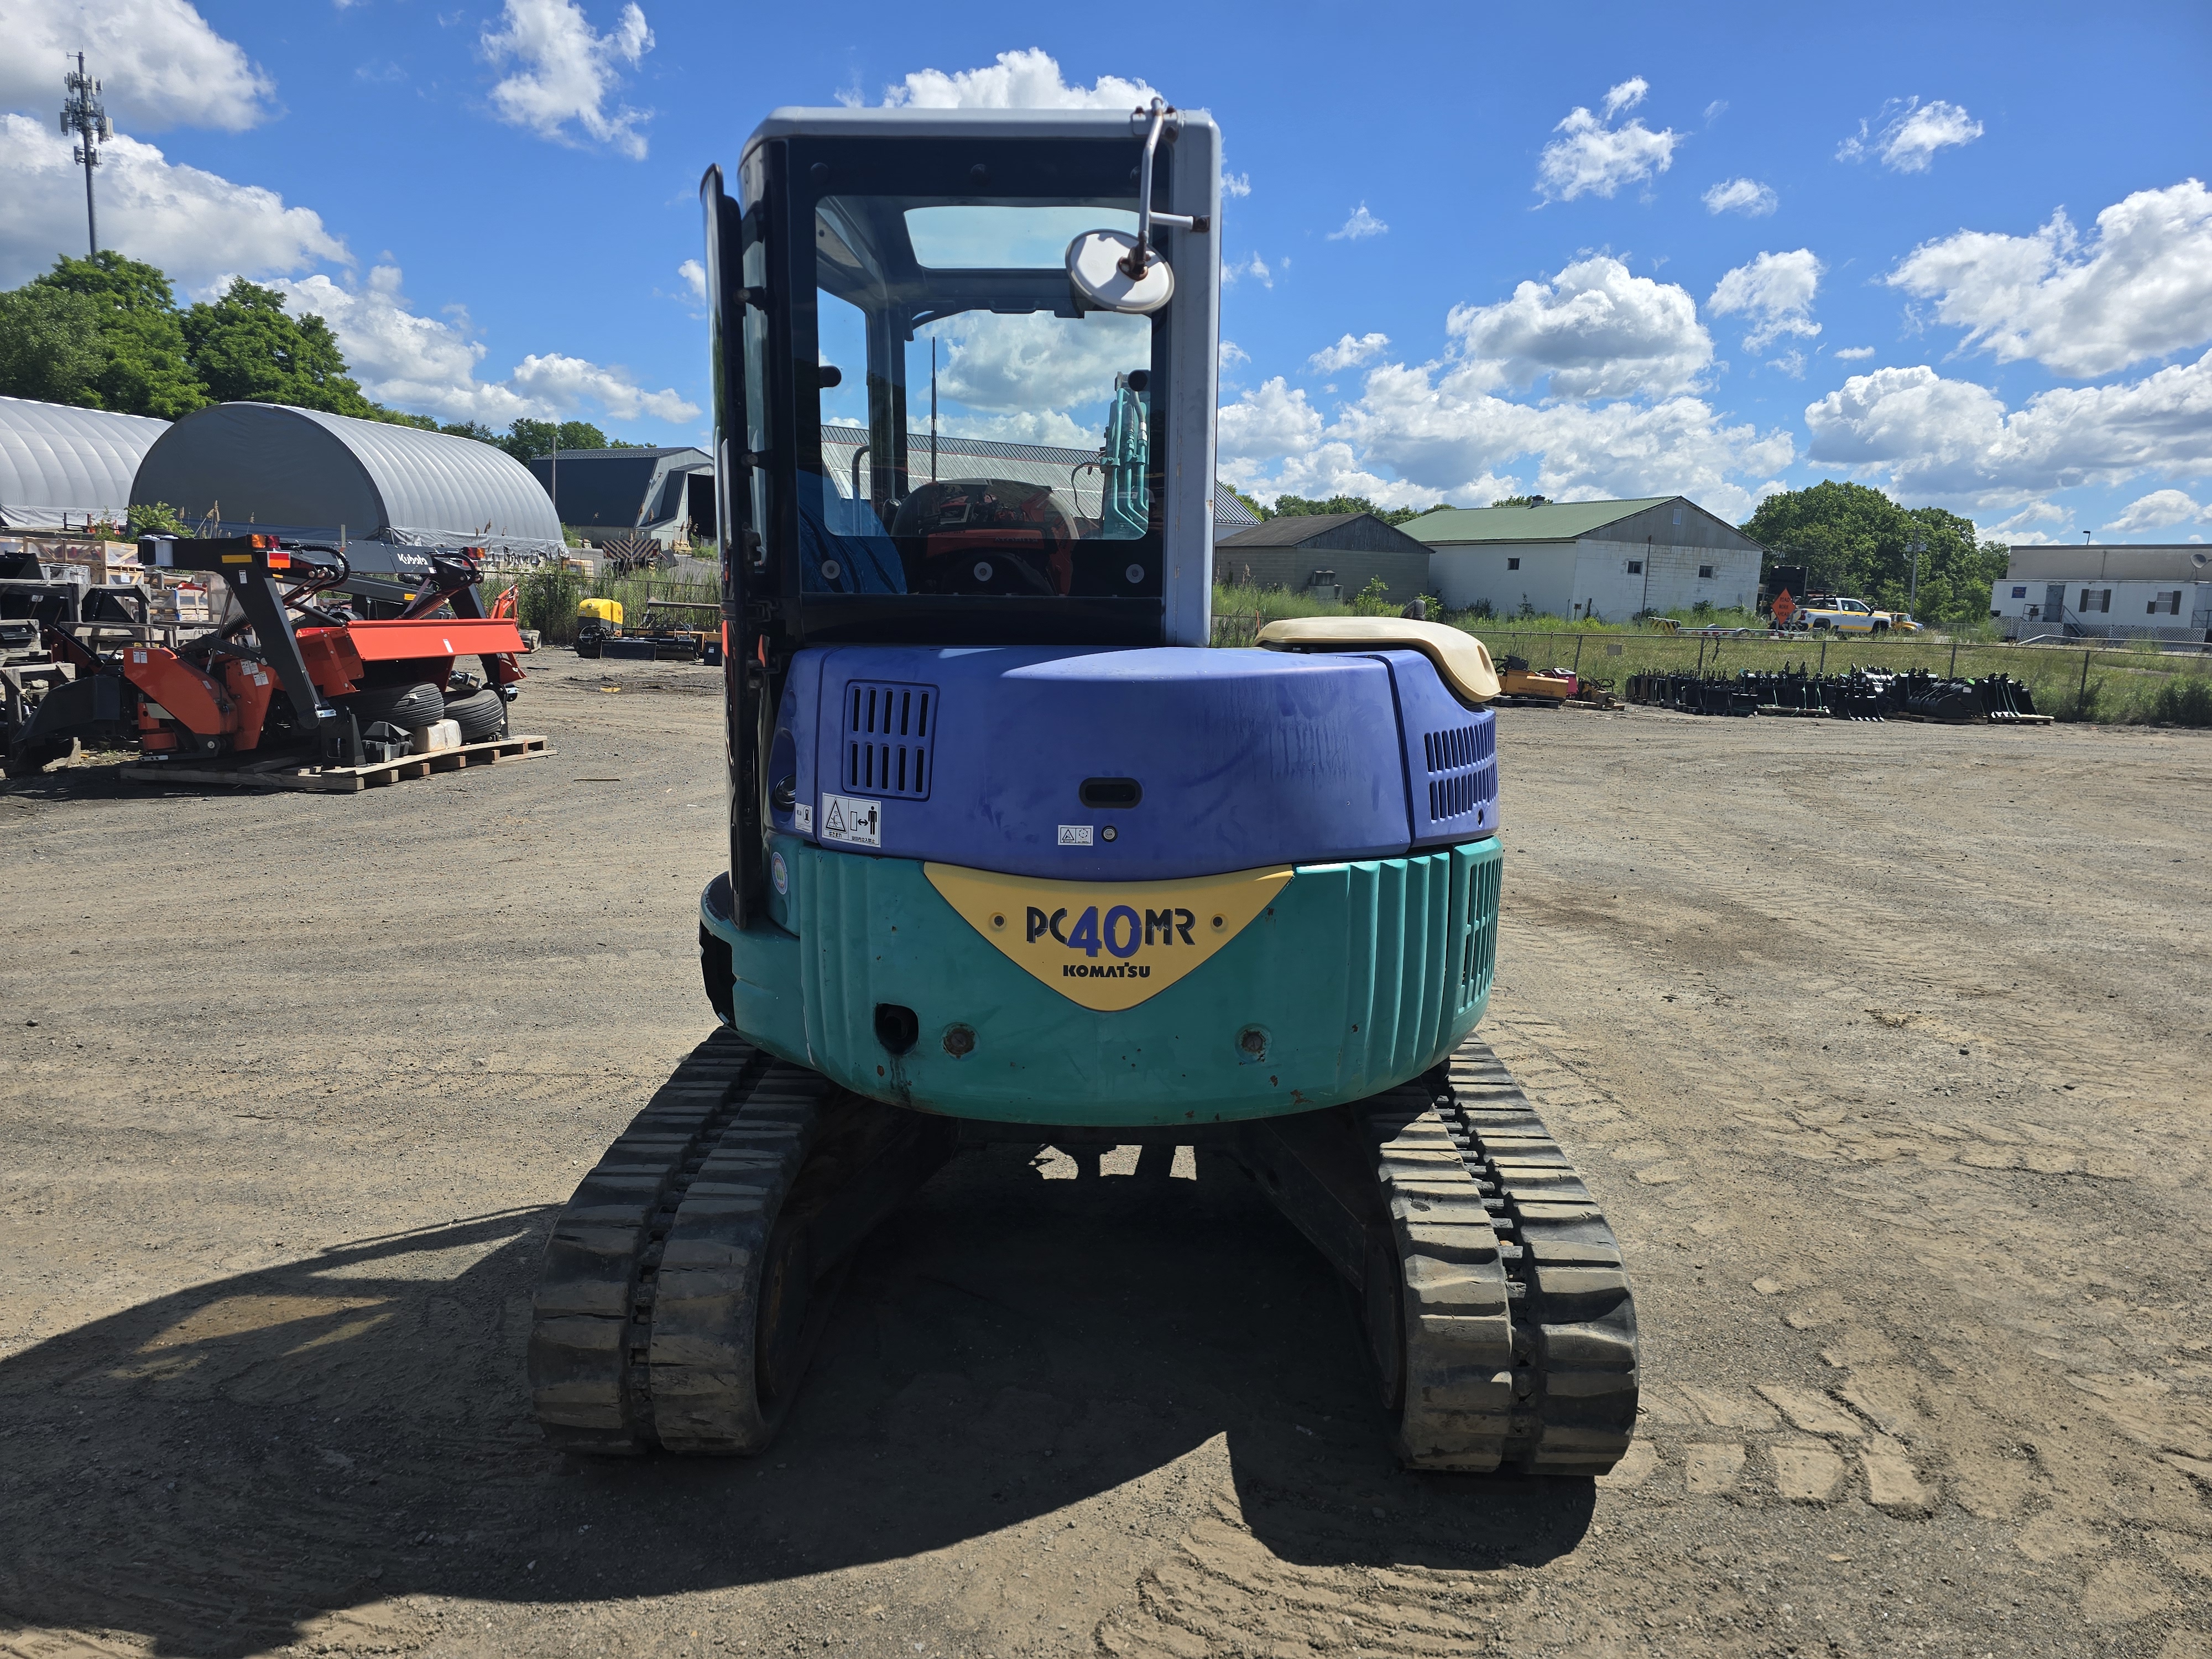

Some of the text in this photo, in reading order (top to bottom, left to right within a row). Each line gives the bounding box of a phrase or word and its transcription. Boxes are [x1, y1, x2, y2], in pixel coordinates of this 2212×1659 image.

[397, 554, 429, 565] Kubota
[1026, 905, 1196, 958] PC40MR
[1063, 962, 1151, 978] KOMATSU
